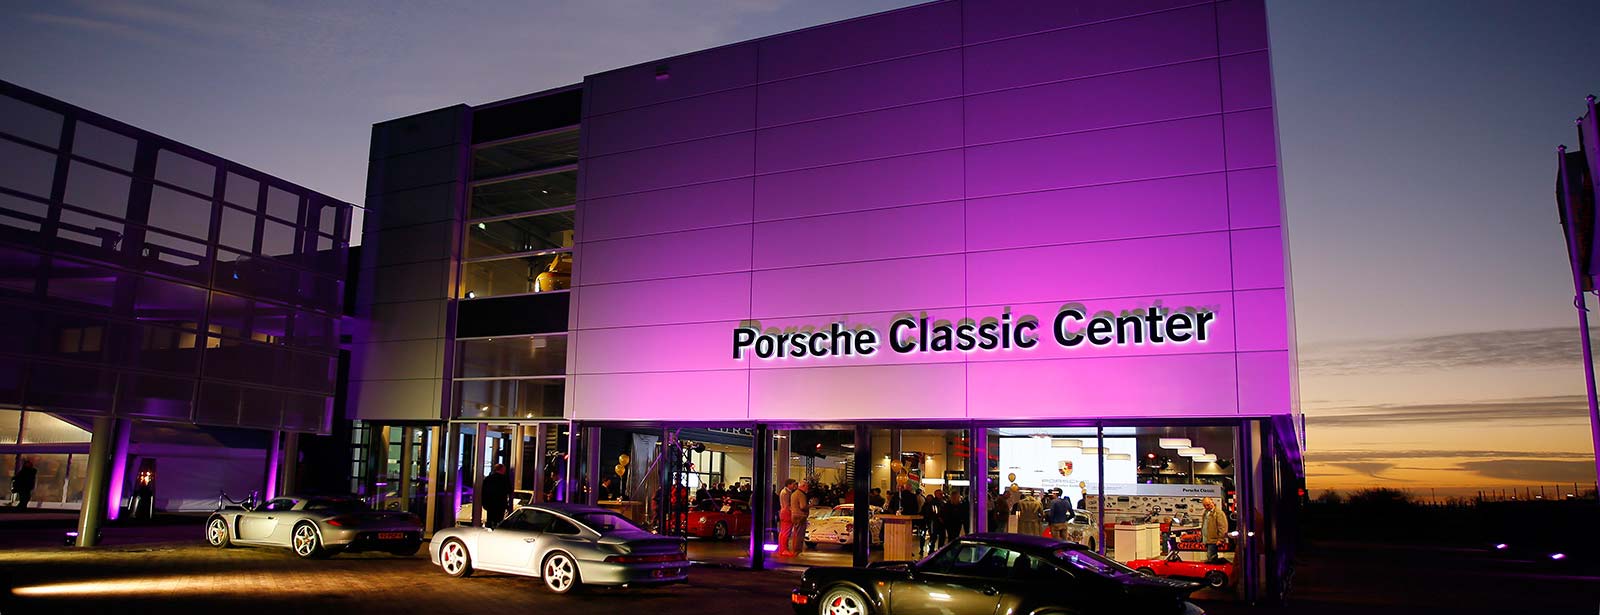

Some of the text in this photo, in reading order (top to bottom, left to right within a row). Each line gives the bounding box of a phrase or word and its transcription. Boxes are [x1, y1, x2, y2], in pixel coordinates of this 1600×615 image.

[732, 306, 1215, 359] Porsche Classic Center
